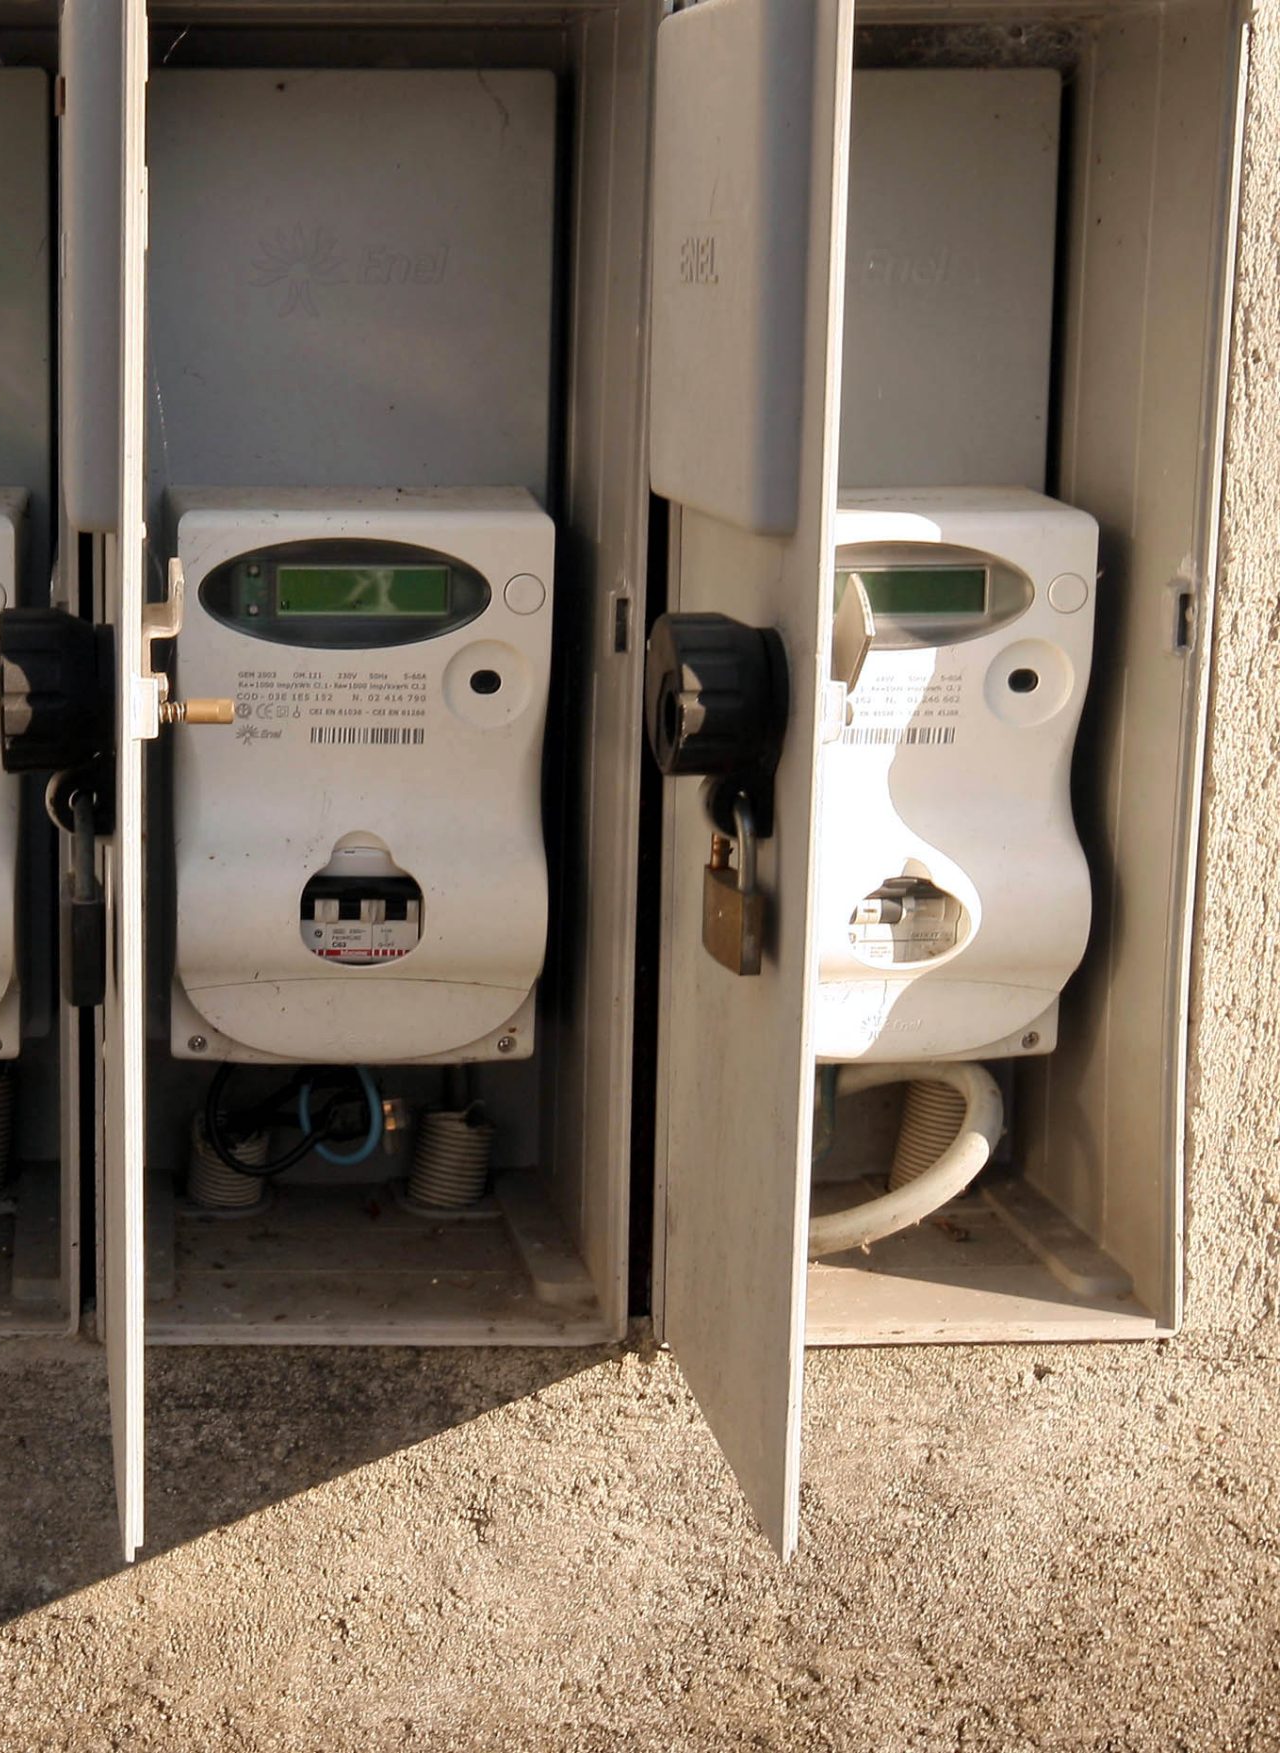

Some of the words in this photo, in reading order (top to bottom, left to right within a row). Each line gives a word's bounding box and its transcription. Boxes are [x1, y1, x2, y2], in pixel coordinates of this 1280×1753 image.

[355, 241, 451, 286] Enel
[680, 236, 719, 284] ENEL
[236, 693, 258, 701] COD
